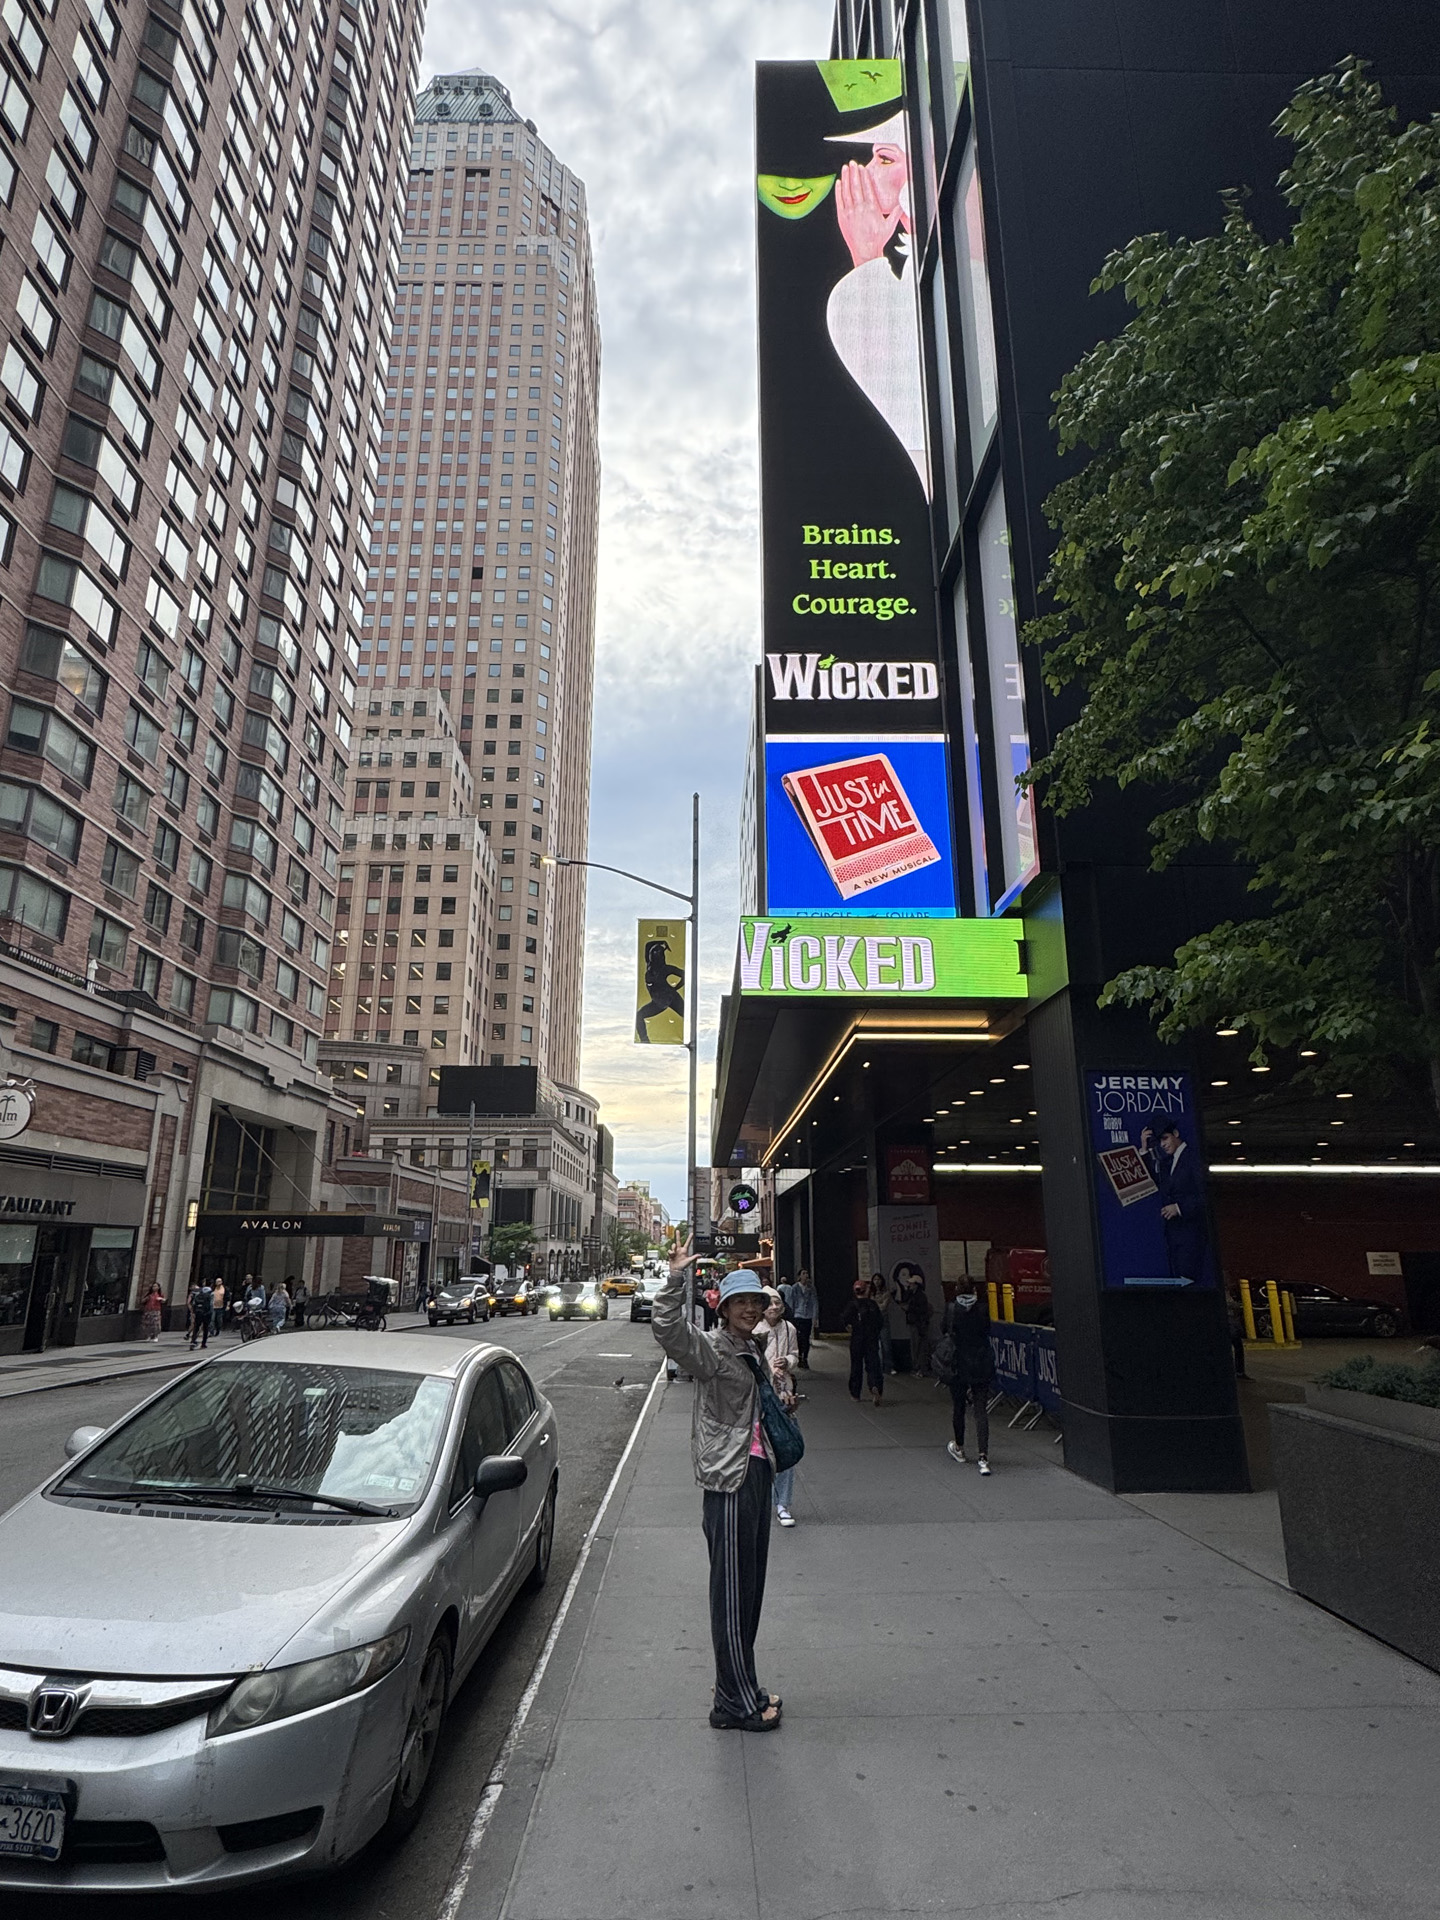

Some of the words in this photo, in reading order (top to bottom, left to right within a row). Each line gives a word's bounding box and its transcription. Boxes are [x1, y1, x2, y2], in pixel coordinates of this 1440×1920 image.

[802, 523, 900, 544] Brains.
[809, 559, 897, 579] Heart.
[792, 594, 917, 620] Courage.
[810, 774, 876, 818] JUST
[871, 780, 891, 798] in
[817, 799, 913, 845] TIME
[853, 883, 862, 891] A
[864, 872, 890, 886] NEW
[892, 855, 936, 875] MUSICAL
[1094, 1076, 1184, 1090] JEREMY
[1096, 1091, 1185, 1113] JORDAN
[1107, 1154, 1133, 1172] JUST
[1111, 1165, 1148, 1185] TIME
[240, 1220, 302, 1230] AVALON
[890, 1220, 928, 1233] CONNIE
[714, 1235, 735, 1246] 830
[891, 1230, 931, 1243] FRANCIS
[9, 1807, 55, 1843] 3620
